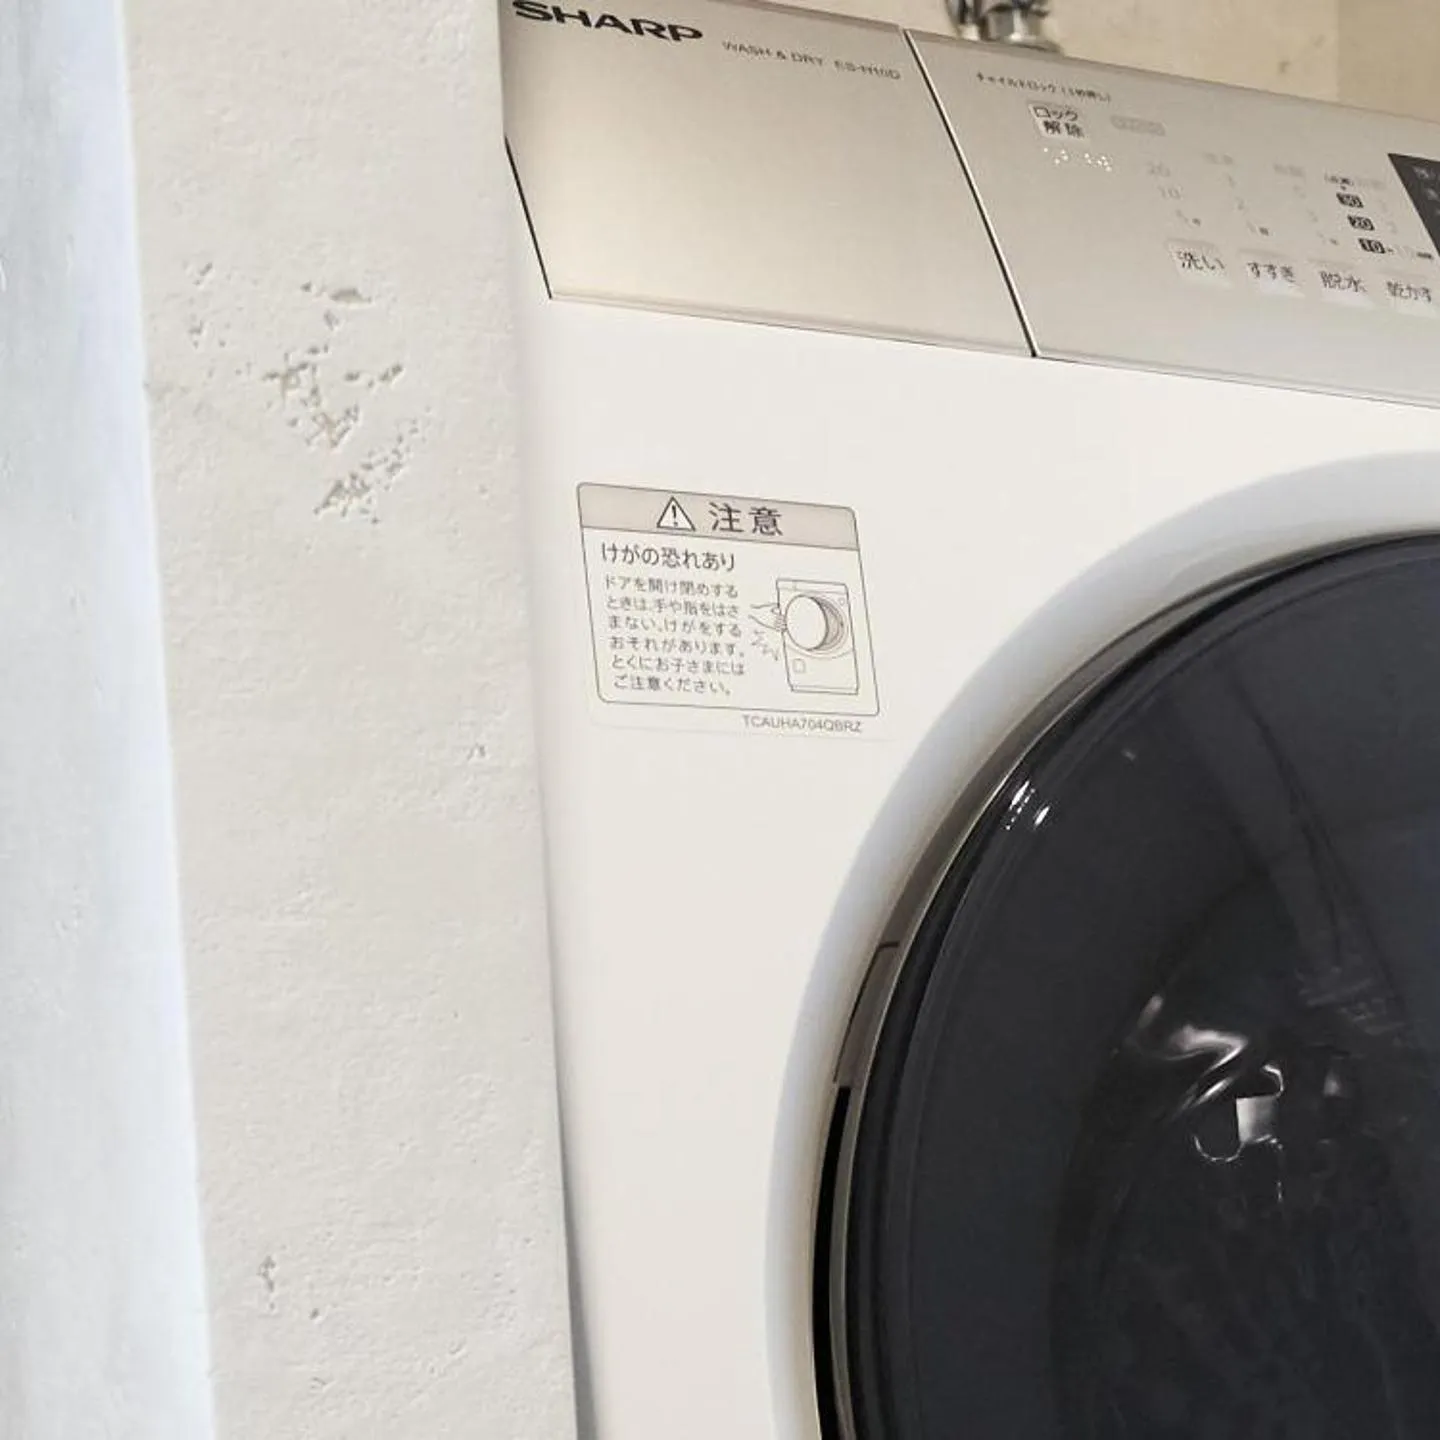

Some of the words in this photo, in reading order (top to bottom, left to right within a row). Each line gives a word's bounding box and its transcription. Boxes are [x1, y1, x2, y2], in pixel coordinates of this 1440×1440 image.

[512, 0, 704, 42] SHARP
[722, 41, 772, 57] WASH
[790, 51, 824, 66] DRY
[1033, 106, 1079, 121] ロック
[1042, 120, 1085, 138] 解除
[1177, 251, 1225, 271] 洗い
[1247, 262, 1296, 283] すすぎ
[1319, 270, 1368, 293] 脱水
[708, 502, 783, 536] 注意
[601, 542, 736, 571] けがの恐れあり
[606, 574, 738, 598] ドアを開け閉めする
[609, 636, 744, 658] おそれがあります。
[612, 655, 744, 675] とくにお子さまには
[614, 674, 731, 696] ご注意ください。
